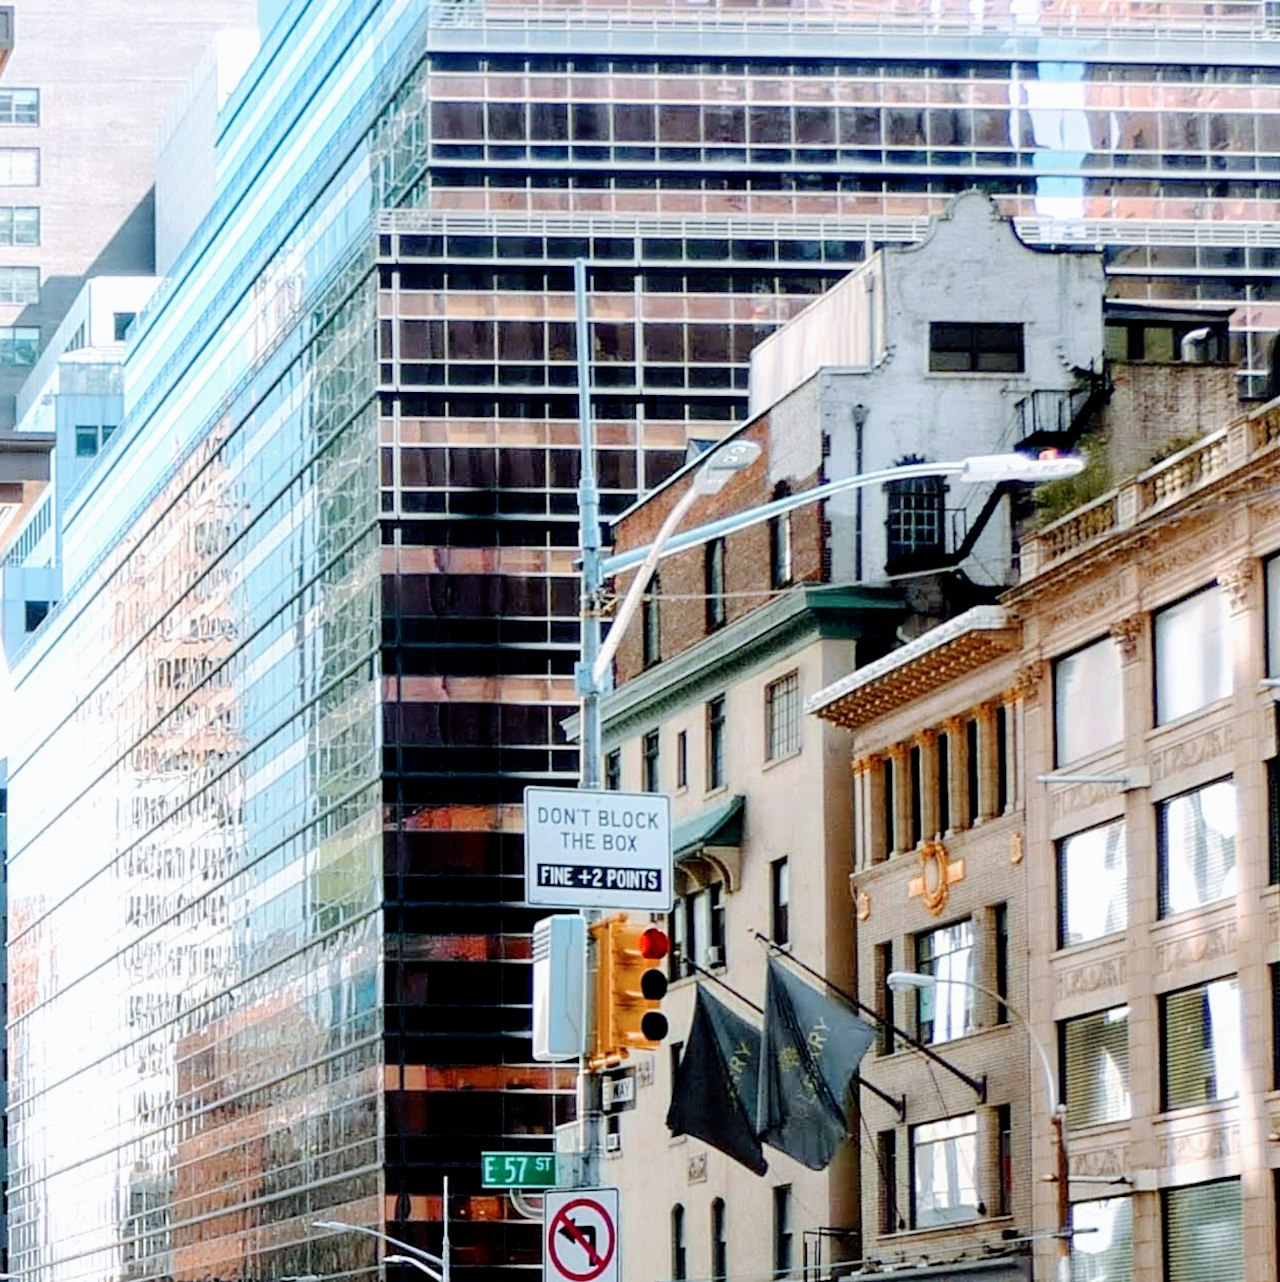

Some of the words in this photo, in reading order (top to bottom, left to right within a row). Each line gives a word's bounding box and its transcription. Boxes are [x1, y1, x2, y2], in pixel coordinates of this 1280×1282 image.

[538, 807, 592, 826] DON'T
[598, 810, 659, 829] BLOCK
[561, 832, 596, 850] THE
[603, 834, 638, 852] BOX
[541, 866, 573, 886] FINE
[578, 868, 603, 887] +2
[607, 870, 658, 890] POINTS
[485, 1157, 496, 1183] E
[504, 1157, 528, 1183] 57
[535, 1157, 552, 1171] ST
